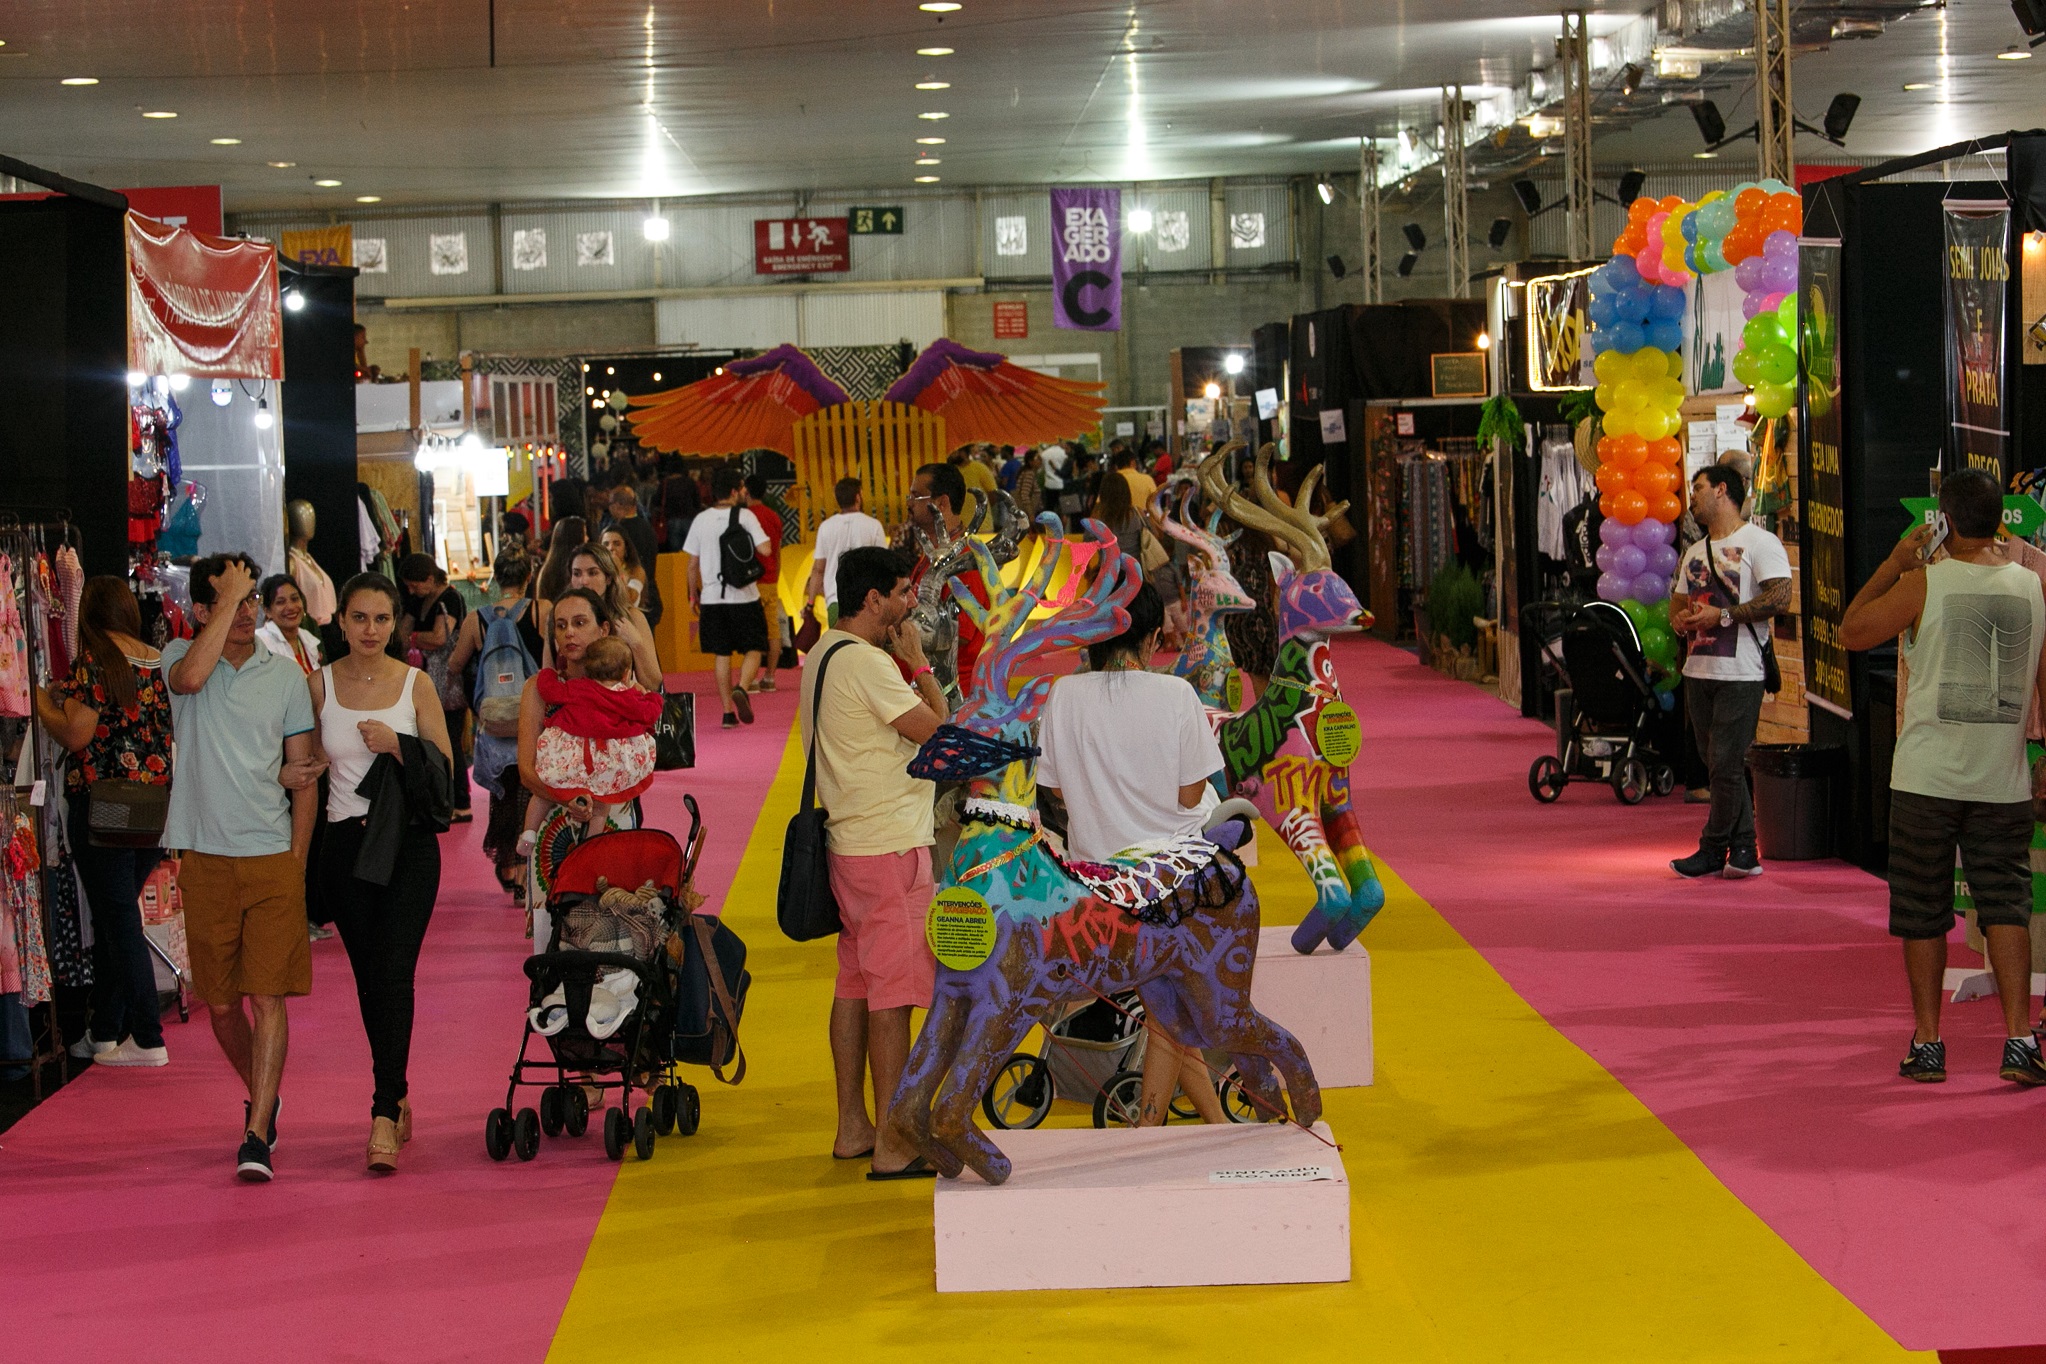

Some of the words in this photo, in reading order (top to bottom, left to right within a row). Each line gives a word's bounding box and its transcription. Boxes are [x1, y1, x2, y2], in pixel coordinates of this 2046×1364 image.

[1066, 207, 1109, 227] EXA
[1063, 227, 1109, 245] GER
[1063, 244, 1111, 263] ADO
[1063, 270, 1113, 327] C
[1977, 309, 1983, 342] E
[1966, 370, 1998, 407] PRATA
[937, 900, 983, 908] INTERVENÇÕES
[937, 916, 964, 924] GEANNA
[965, 917, 987, 925] ABREU
